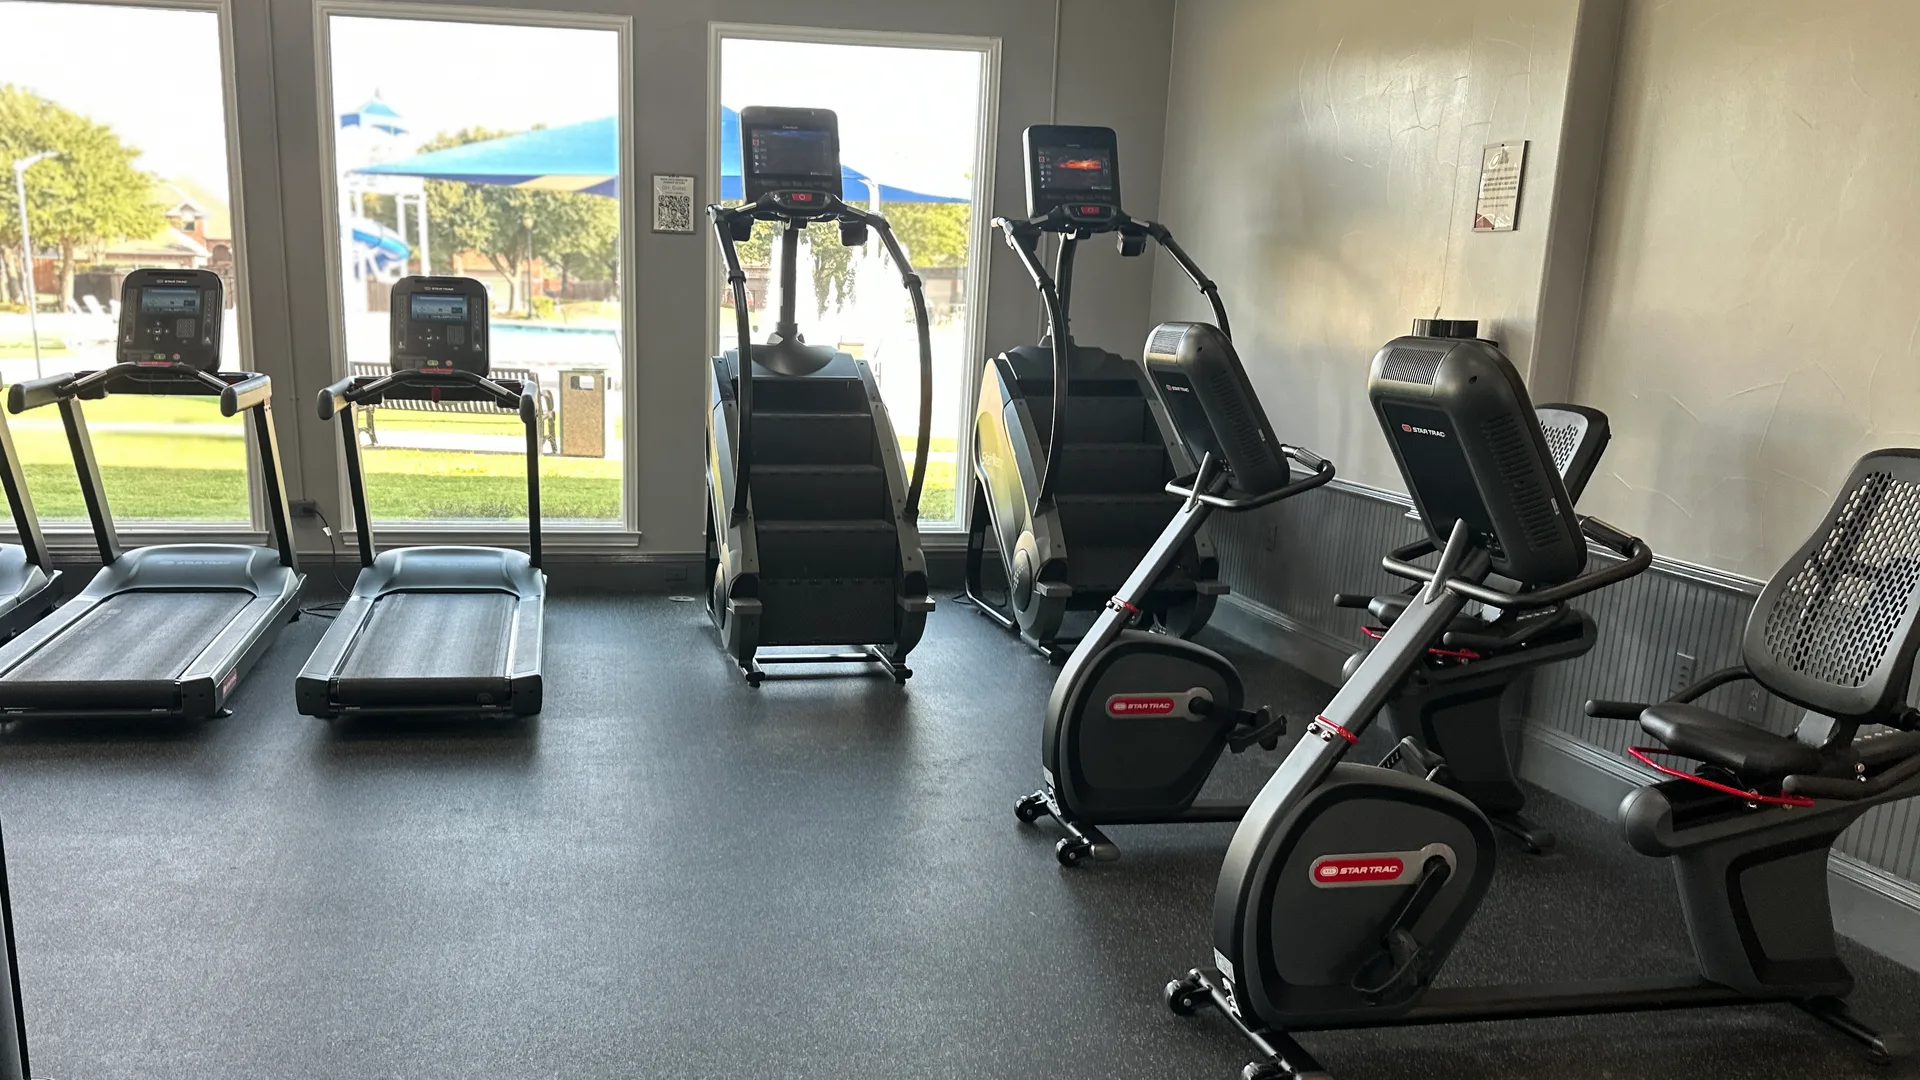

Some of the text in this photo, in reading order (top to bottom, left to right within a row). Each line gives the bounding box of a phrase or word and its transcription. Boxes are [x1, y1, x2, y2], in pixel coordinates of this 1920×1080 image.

[1412, 426, 1446, 438] STAR TRAC
[1340, 865, 1398, 875] STAR TRAC
